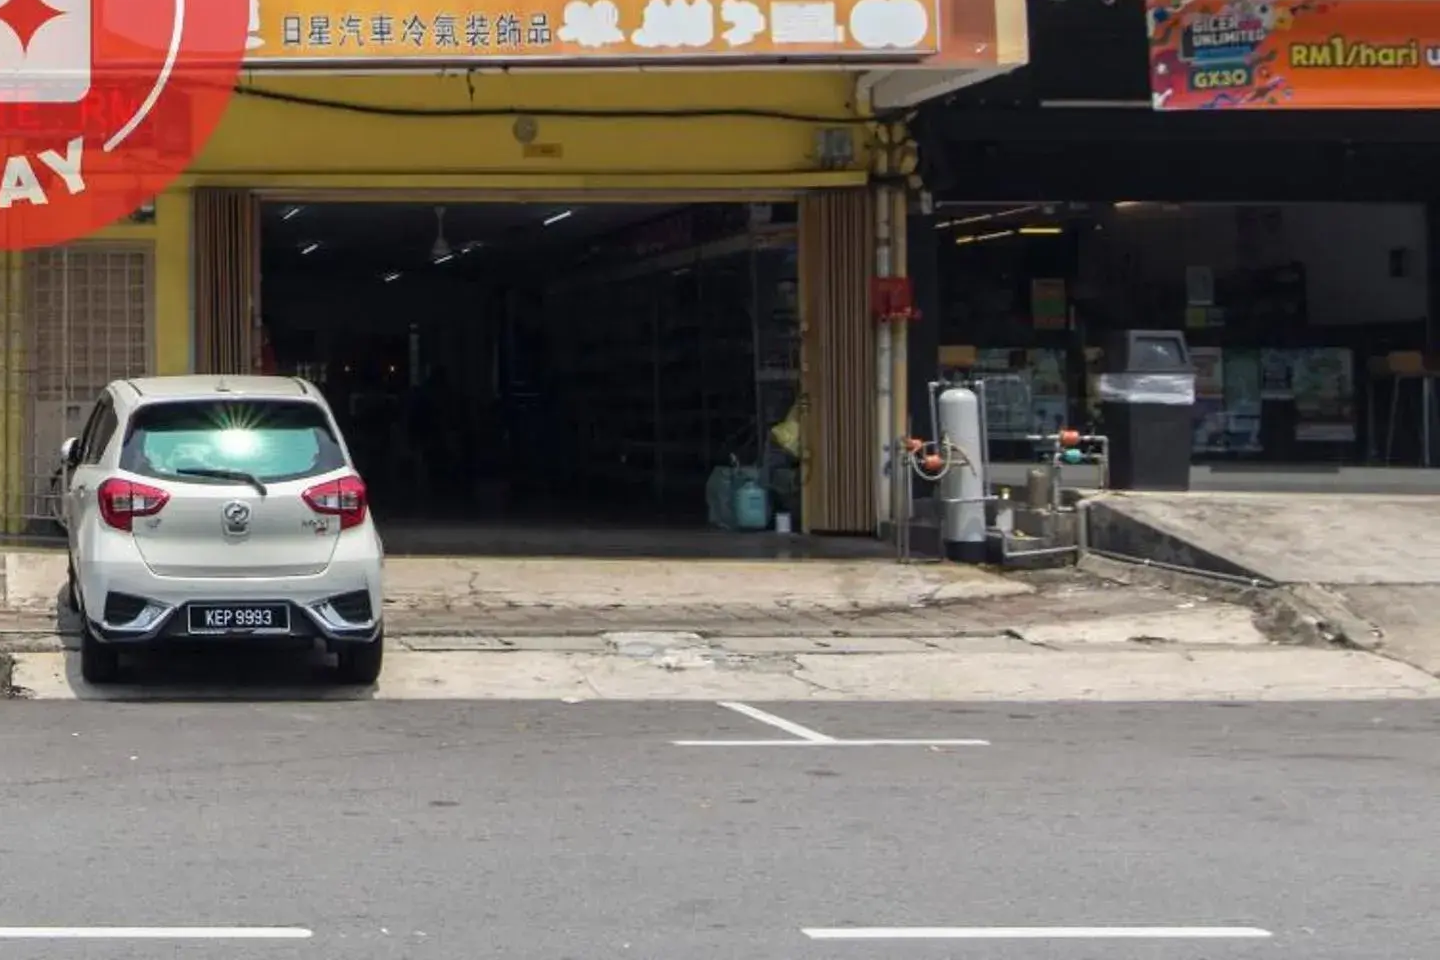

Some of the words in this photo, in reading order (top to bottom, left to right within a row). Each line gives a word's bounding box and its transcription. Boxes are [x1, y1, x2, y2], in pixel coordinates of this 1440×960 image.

[1291, 37, 1419, 67] RM1/hari
[205, 608, 233, 626] KEP
[235, 607, 272, 626] 9993
